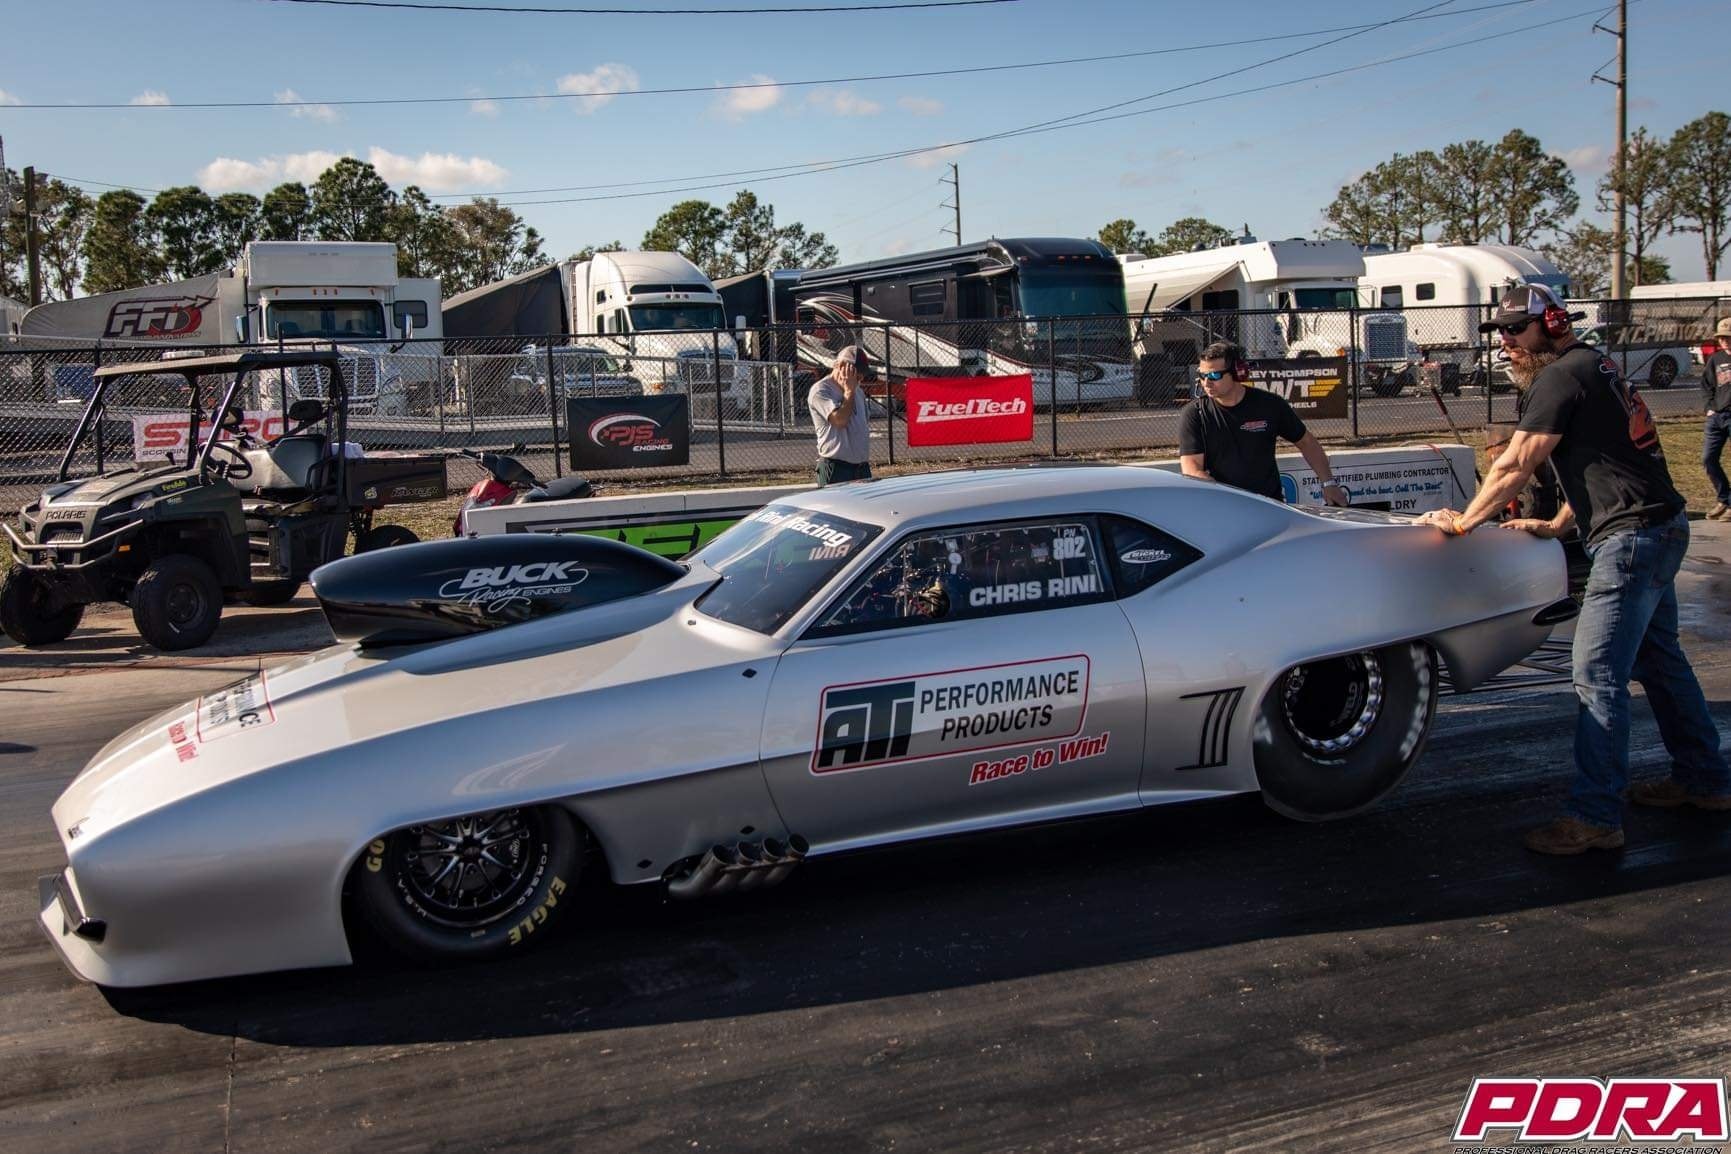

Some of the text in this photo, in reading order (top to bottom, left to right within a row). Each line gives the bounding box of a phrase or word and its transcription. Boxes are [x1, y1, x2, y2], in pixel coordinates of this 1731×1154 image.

[1269, 368, 1338, 378] THOMPSON
[917, 398, 1026, 419] FuelTech
[633, 444, 673, 452] ENGINES
[1302, 476, 1322, 486] STAT
[1365, 472, 1402, 481] PLUMBING
[1403, 467, 1449, 477] CONTRACTOR
[1366, 486, 1378, 495] the
[1395, 482, 1410, 494] Call
[1411, 481, 1424, 492] The
[1053, 536, 1086, 561] 802
[459, 560, 579, 589] BUCK
[458, 585, 572, 613] Racing ENGINES
[969, 574, 1097, 607] CHRIS RINI
[920, 670, 1079, 714] PERFORMANCE
[941, 704, 1053, 742] PRODUCTS
[970, 732, 1110, 785] Race to Win!
[508, 875, 567, 945] EAGLE
